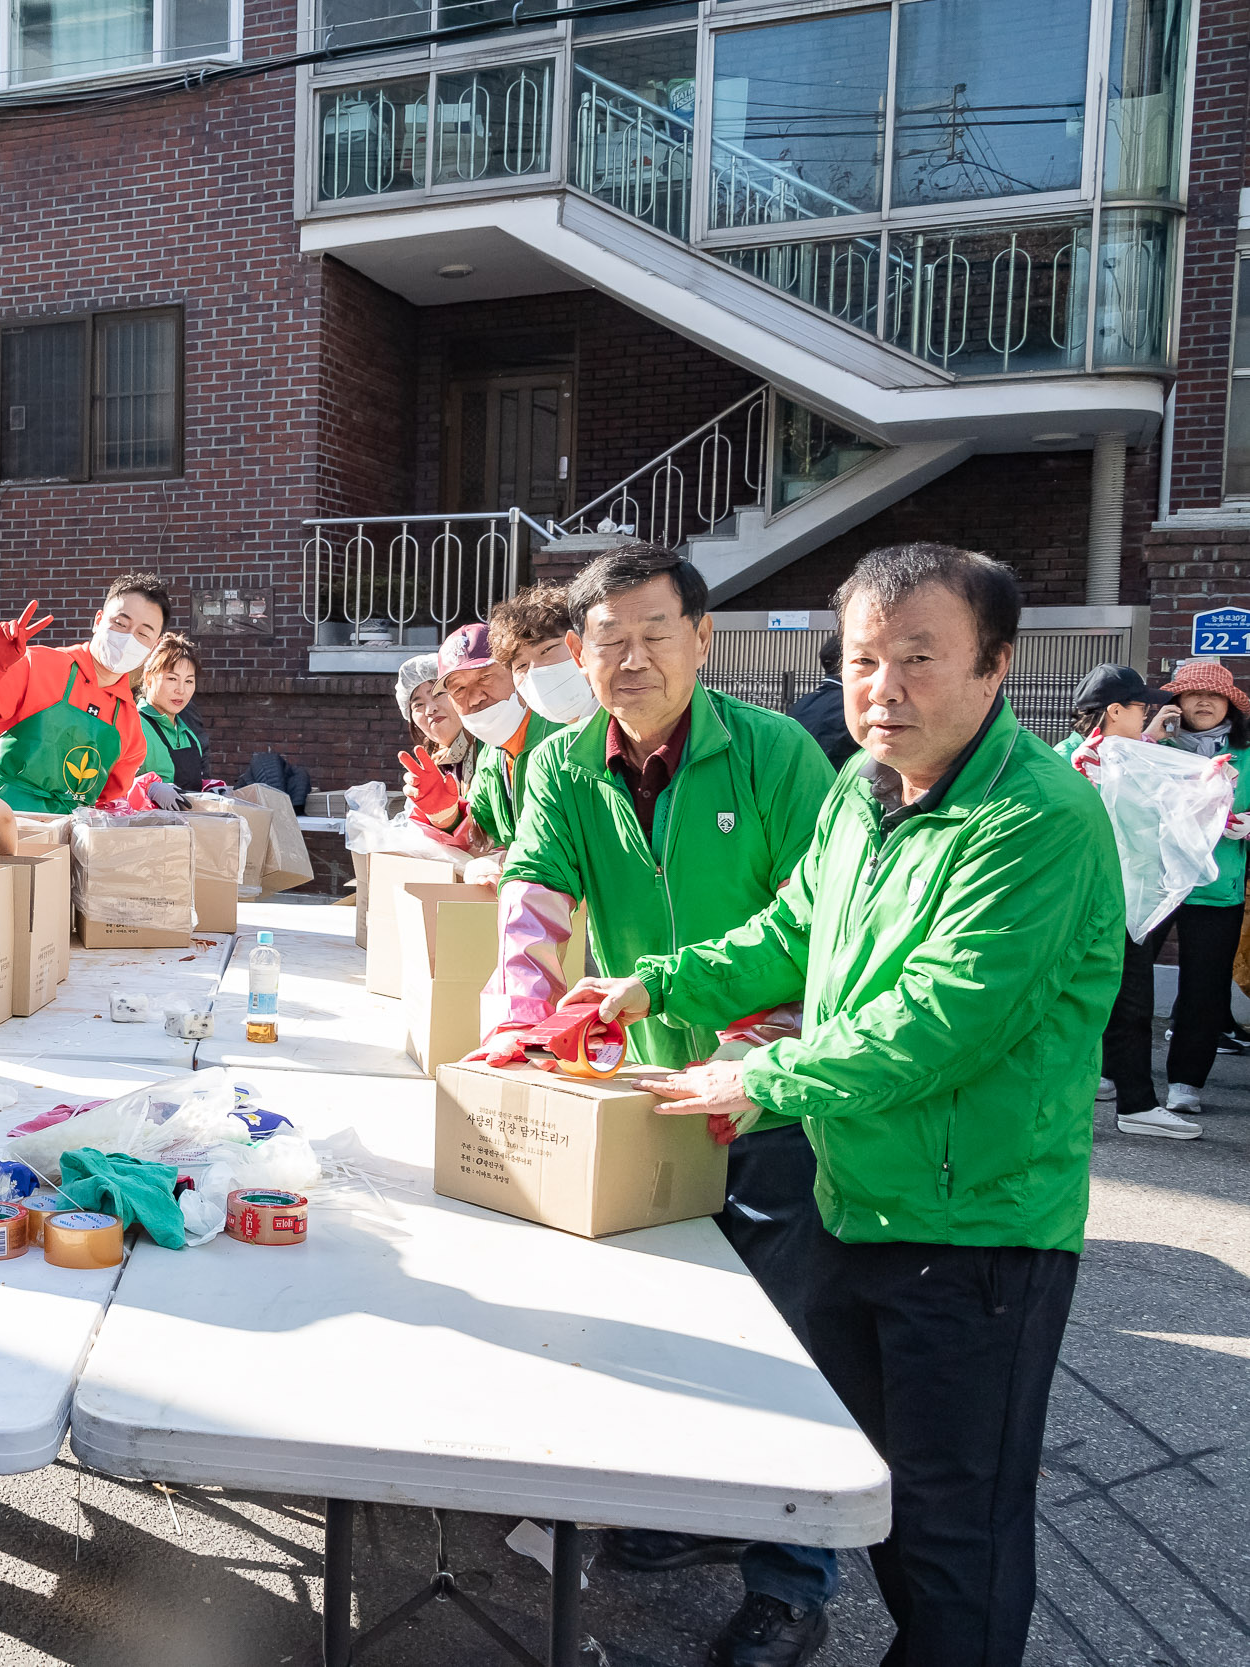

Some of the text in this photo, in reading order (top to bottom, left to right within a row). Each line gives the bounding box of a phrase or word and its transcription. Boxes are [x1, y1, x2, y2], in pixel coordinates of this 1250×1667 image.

[466, 1113, 569, 1148] 사랑의 김장 담가드리기
